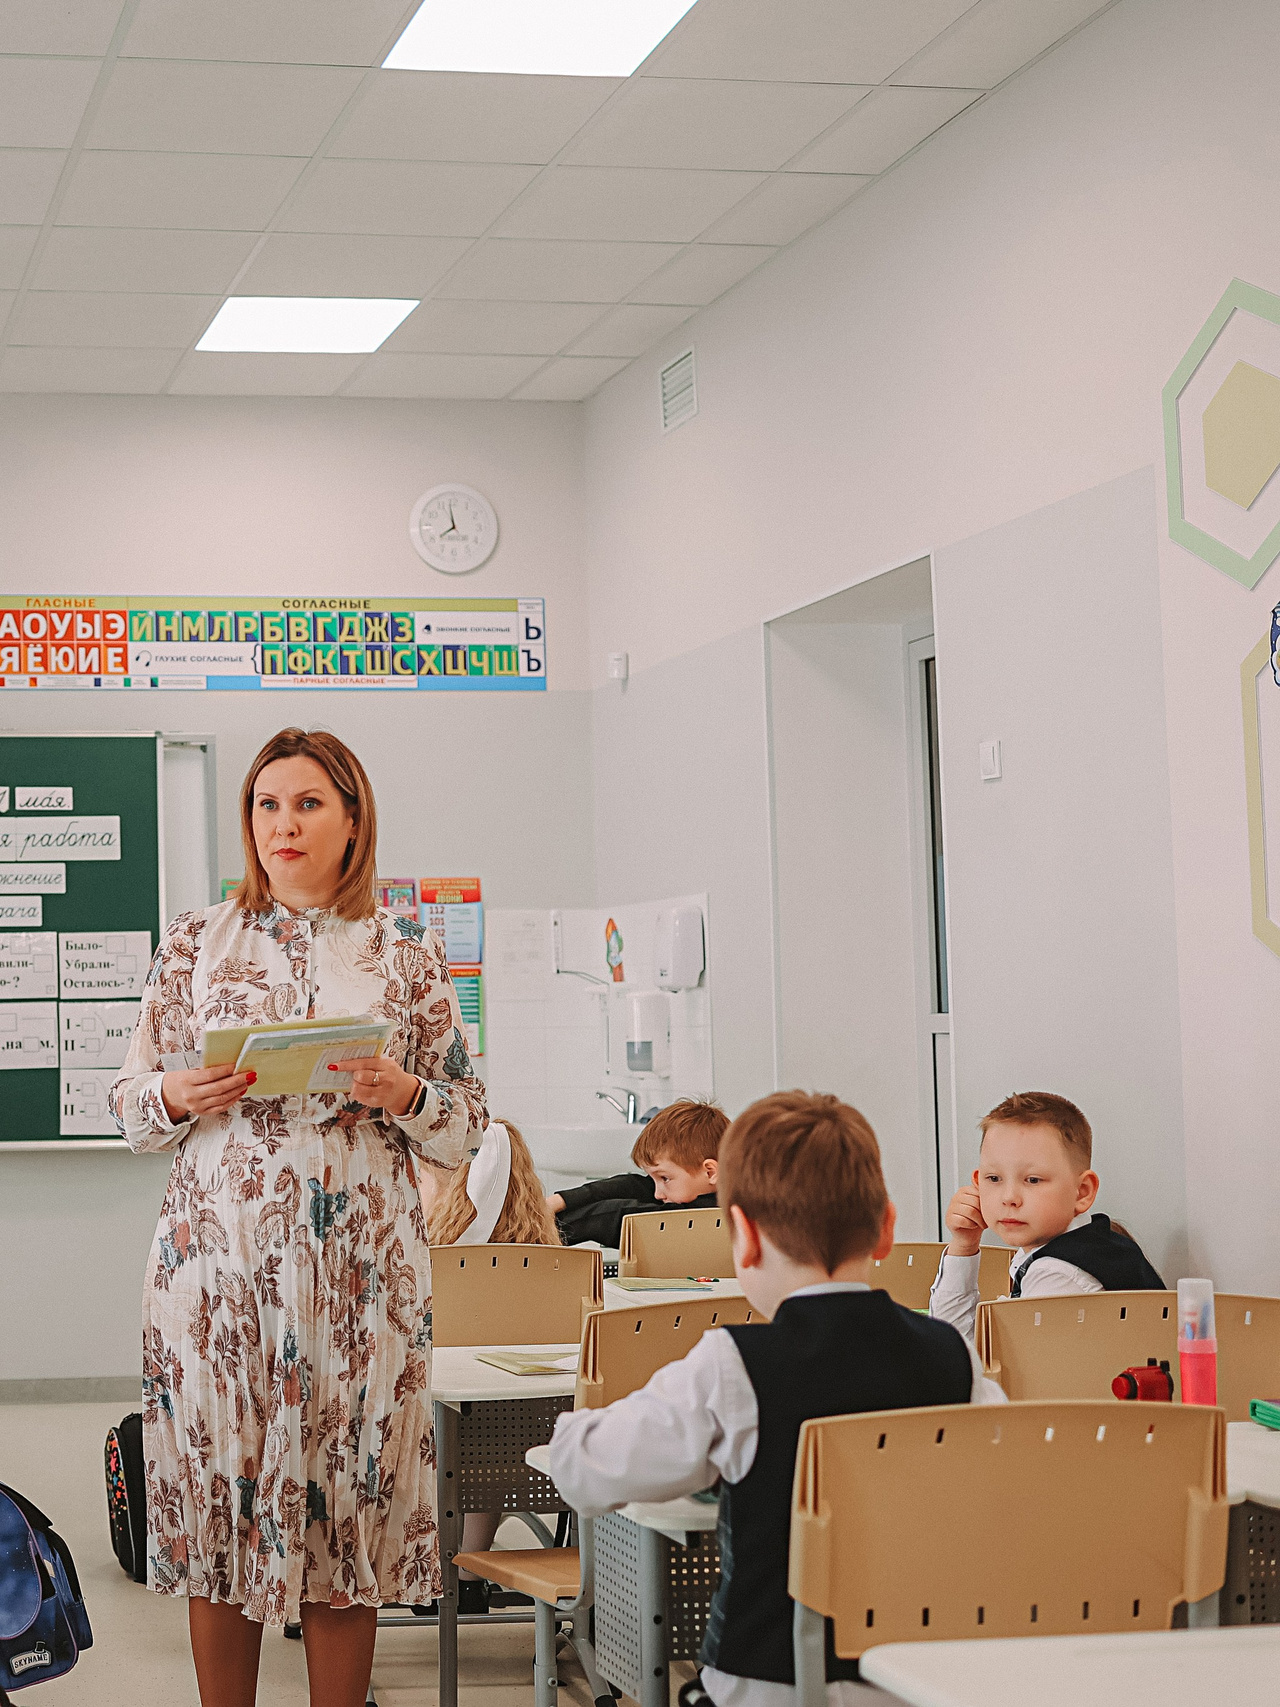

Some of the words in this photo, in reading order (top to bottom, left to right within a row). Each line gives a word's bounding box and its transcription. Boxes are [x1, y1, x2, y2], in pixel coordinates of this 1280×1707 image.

[26, 598, 96, 608] ГЛАСНЫЕ
[282, 600, 371, 609] СОГЛАСНЫЕ
[155, 655, 187, 663] ГЛУХИЕ
[190, 655, 244, 663] СОГЛАСНЫЕ
[20, 821, 116, 858] работа
[429, 906, 445, 914] 112
[429, 918, 445, 926] 101
[434, 928, 446, 937] 02
[14, 1653, 48, 1669] SKYNAME
